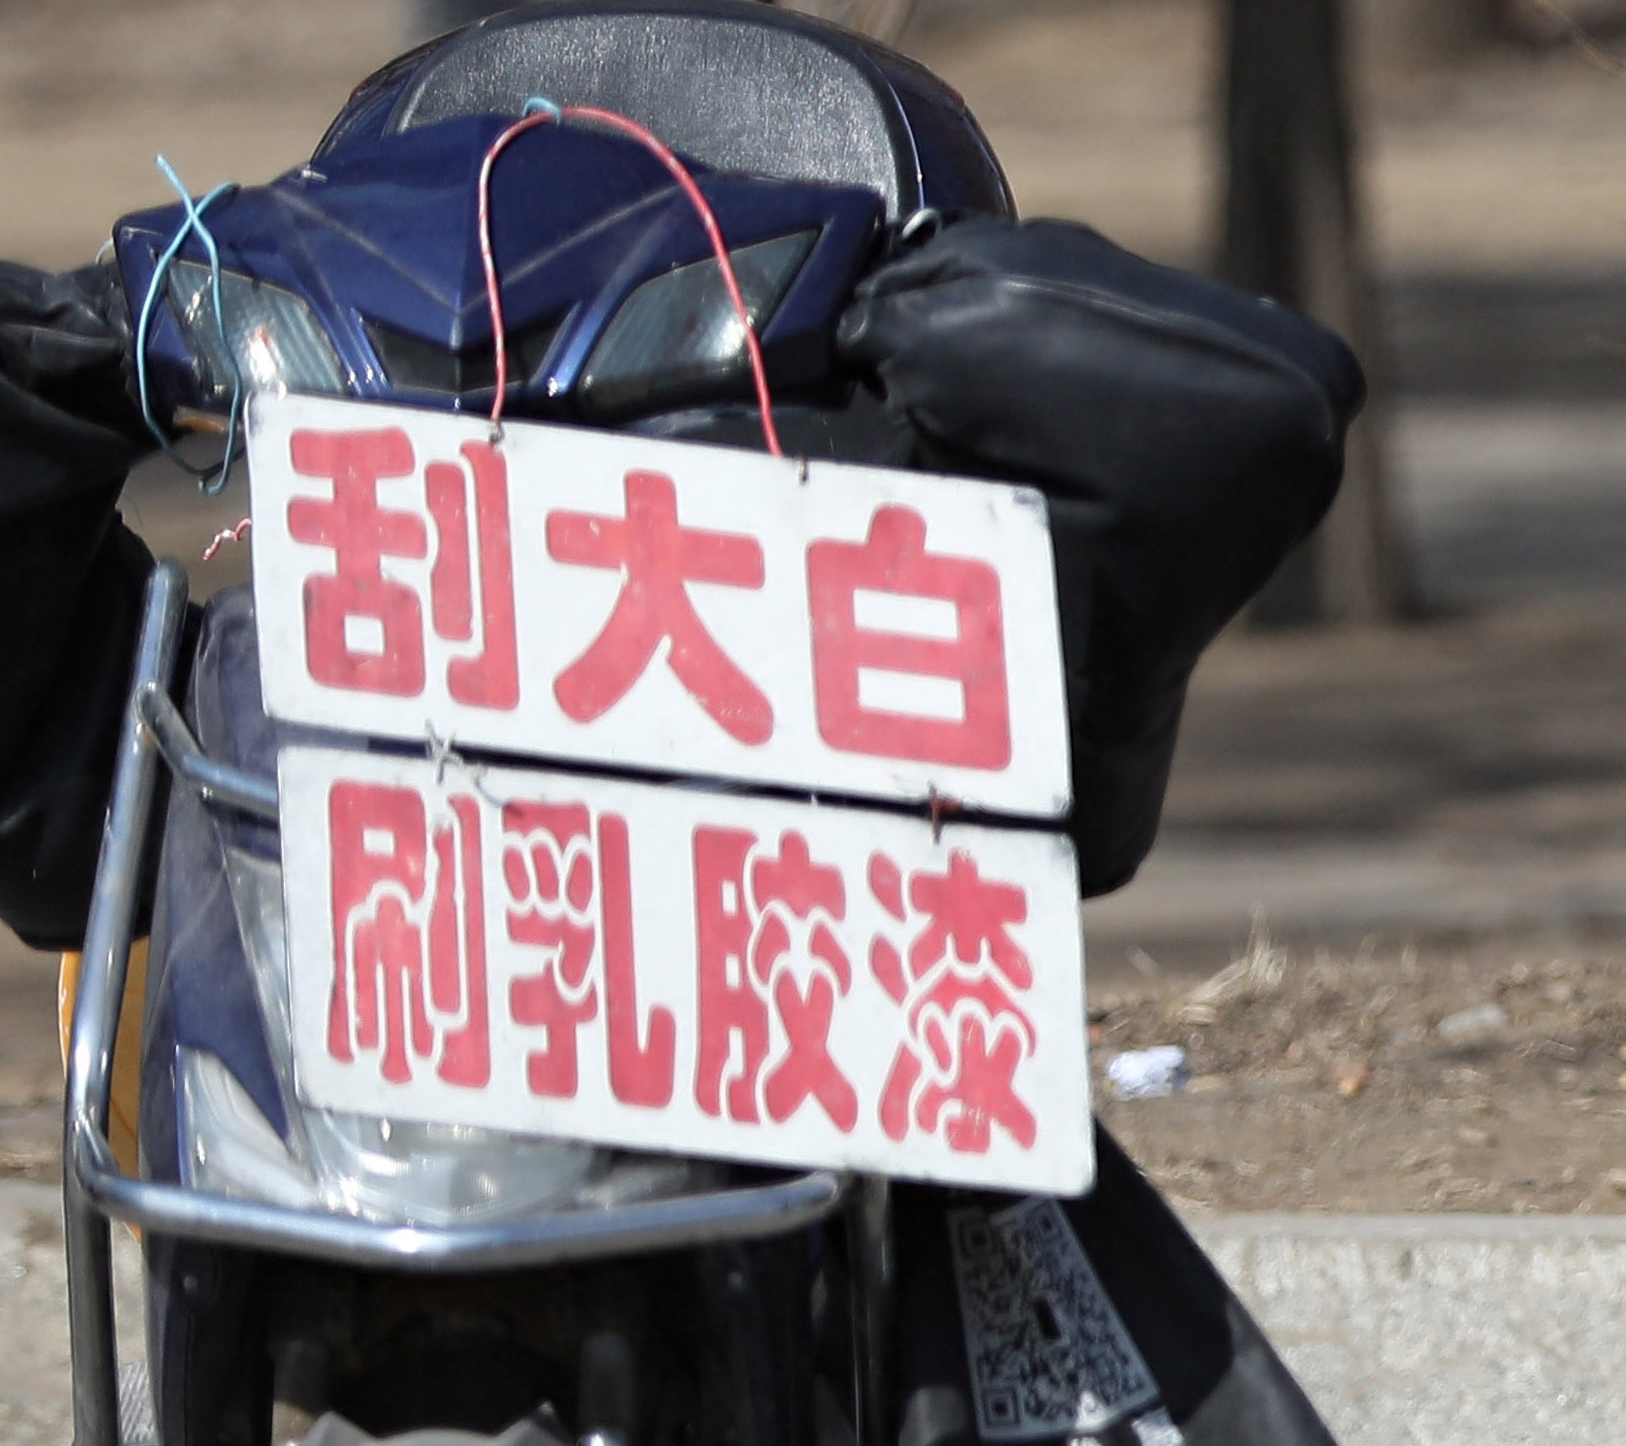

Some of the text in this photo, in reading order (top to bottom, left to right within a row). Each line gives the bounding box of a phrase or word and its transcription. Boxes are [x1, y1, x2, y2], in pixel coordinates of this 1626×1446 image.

[287, 428, 1012, 772] 刮大白
[327, 780, 1037, 1155] 刷乳胶漆
